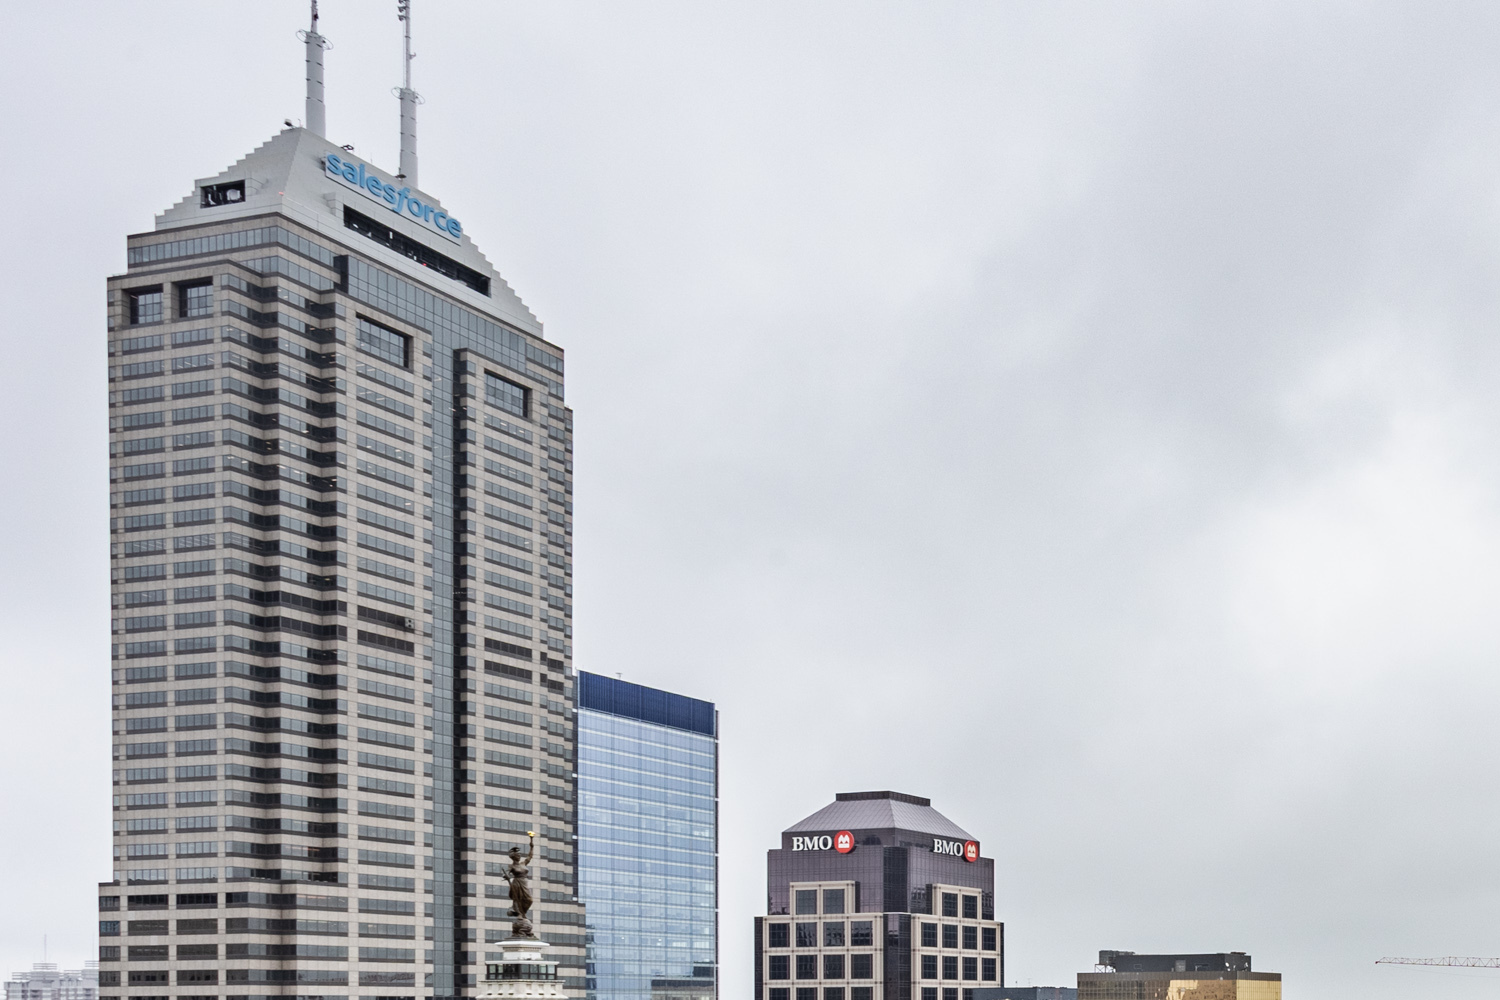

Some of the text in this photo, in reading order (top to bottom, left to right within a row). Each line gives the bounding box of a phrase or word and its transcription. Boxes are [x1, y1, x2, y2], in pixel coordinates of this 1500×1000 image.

[327, 154, 462, 238] salesforce
[792, 836, 832, 851] BMO
[933, 838, 963, 857] BMO
